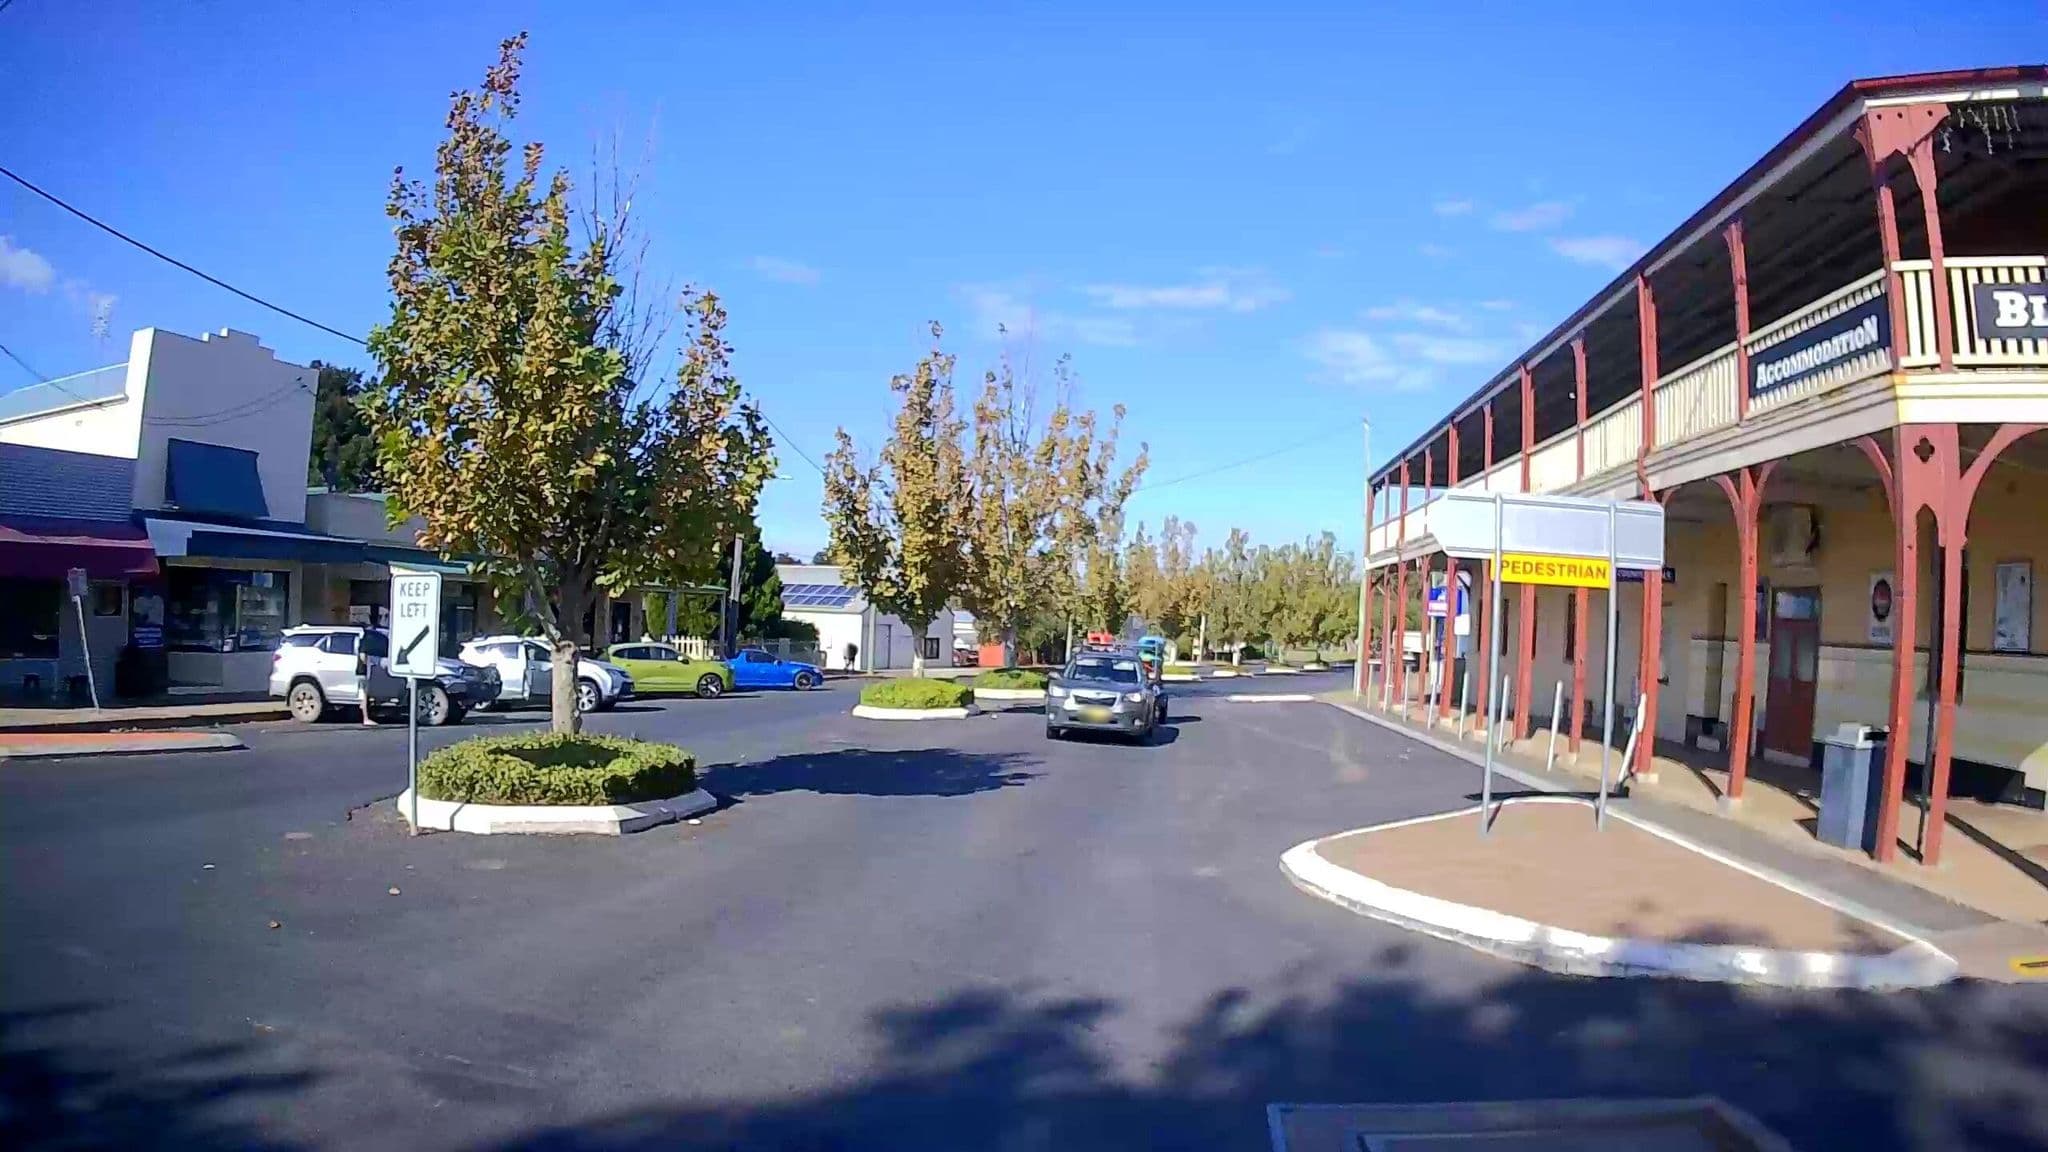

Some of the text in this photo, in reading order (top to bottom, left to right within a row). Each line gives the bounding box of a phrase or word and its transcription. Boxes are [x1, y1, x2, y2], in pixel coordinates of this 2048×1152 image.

[1501, 560, 1607, 580] PEDESTRIAN
[400, 582, 430, 597] KEEP
[400, 602, 428, 618] LEFT
